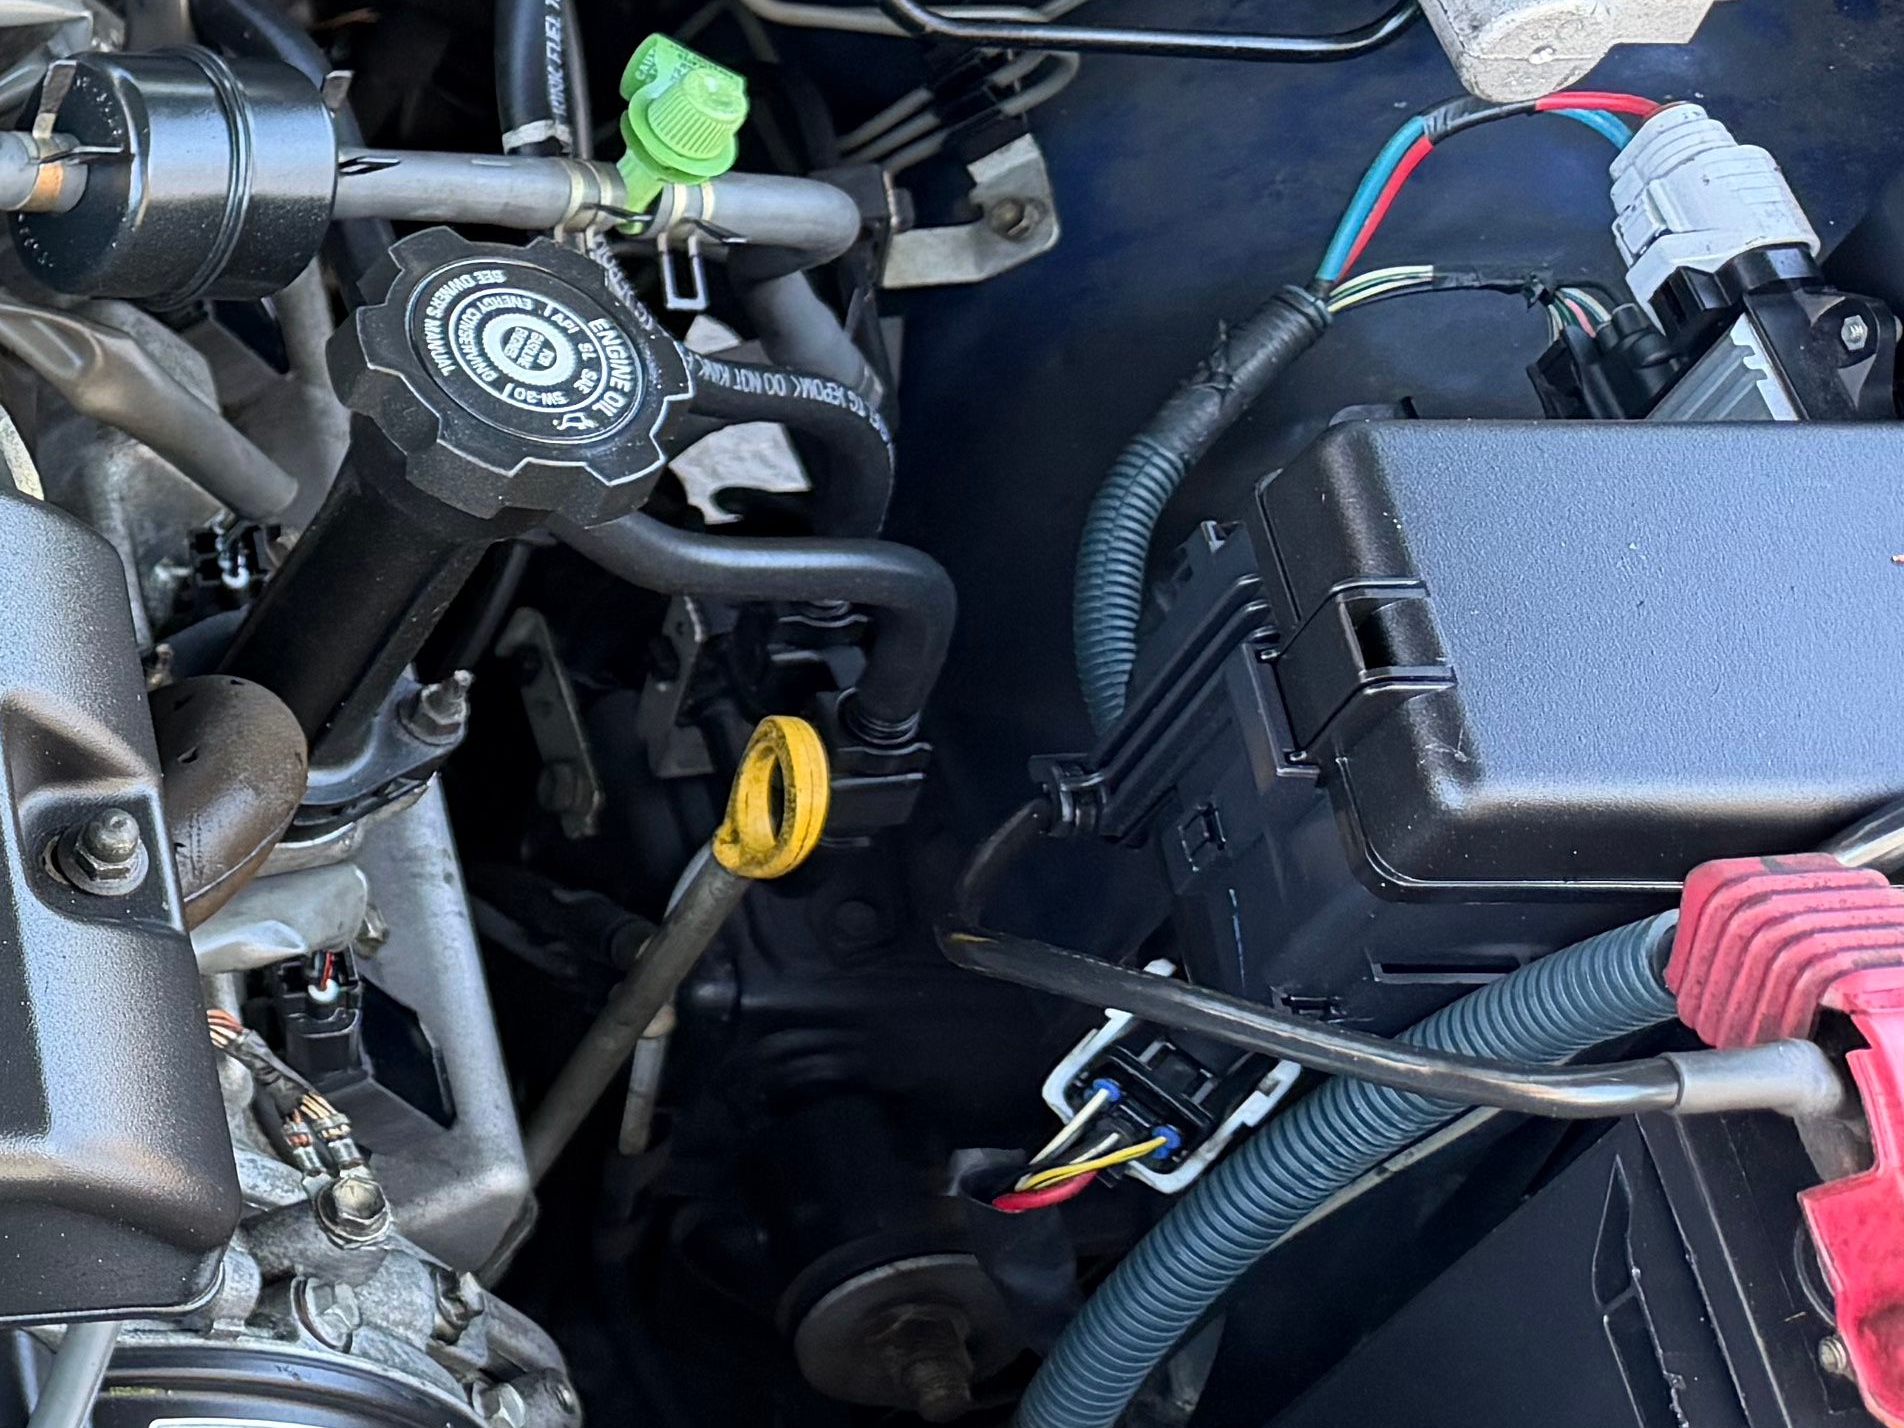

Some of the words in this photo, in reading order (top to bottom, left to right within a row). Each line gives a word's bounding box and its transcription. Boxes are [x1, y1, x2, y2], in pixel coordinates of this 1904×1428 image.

[474, 269, 508, 285] SEE
[478, 295, 535, 315] ENERGY
[424, 317, 458, 378] MANUAL
[457, 311, 500, 383] CONSERVING
[552, 310, 580, 335] API
[573, 368, 600, 396] SAE
[588, 318, 637, 394] ENGINE
[733, 367, 763, 395] NOT
[763, 374, 789, 398] DO
[592, 391, 630, 418] OIL
